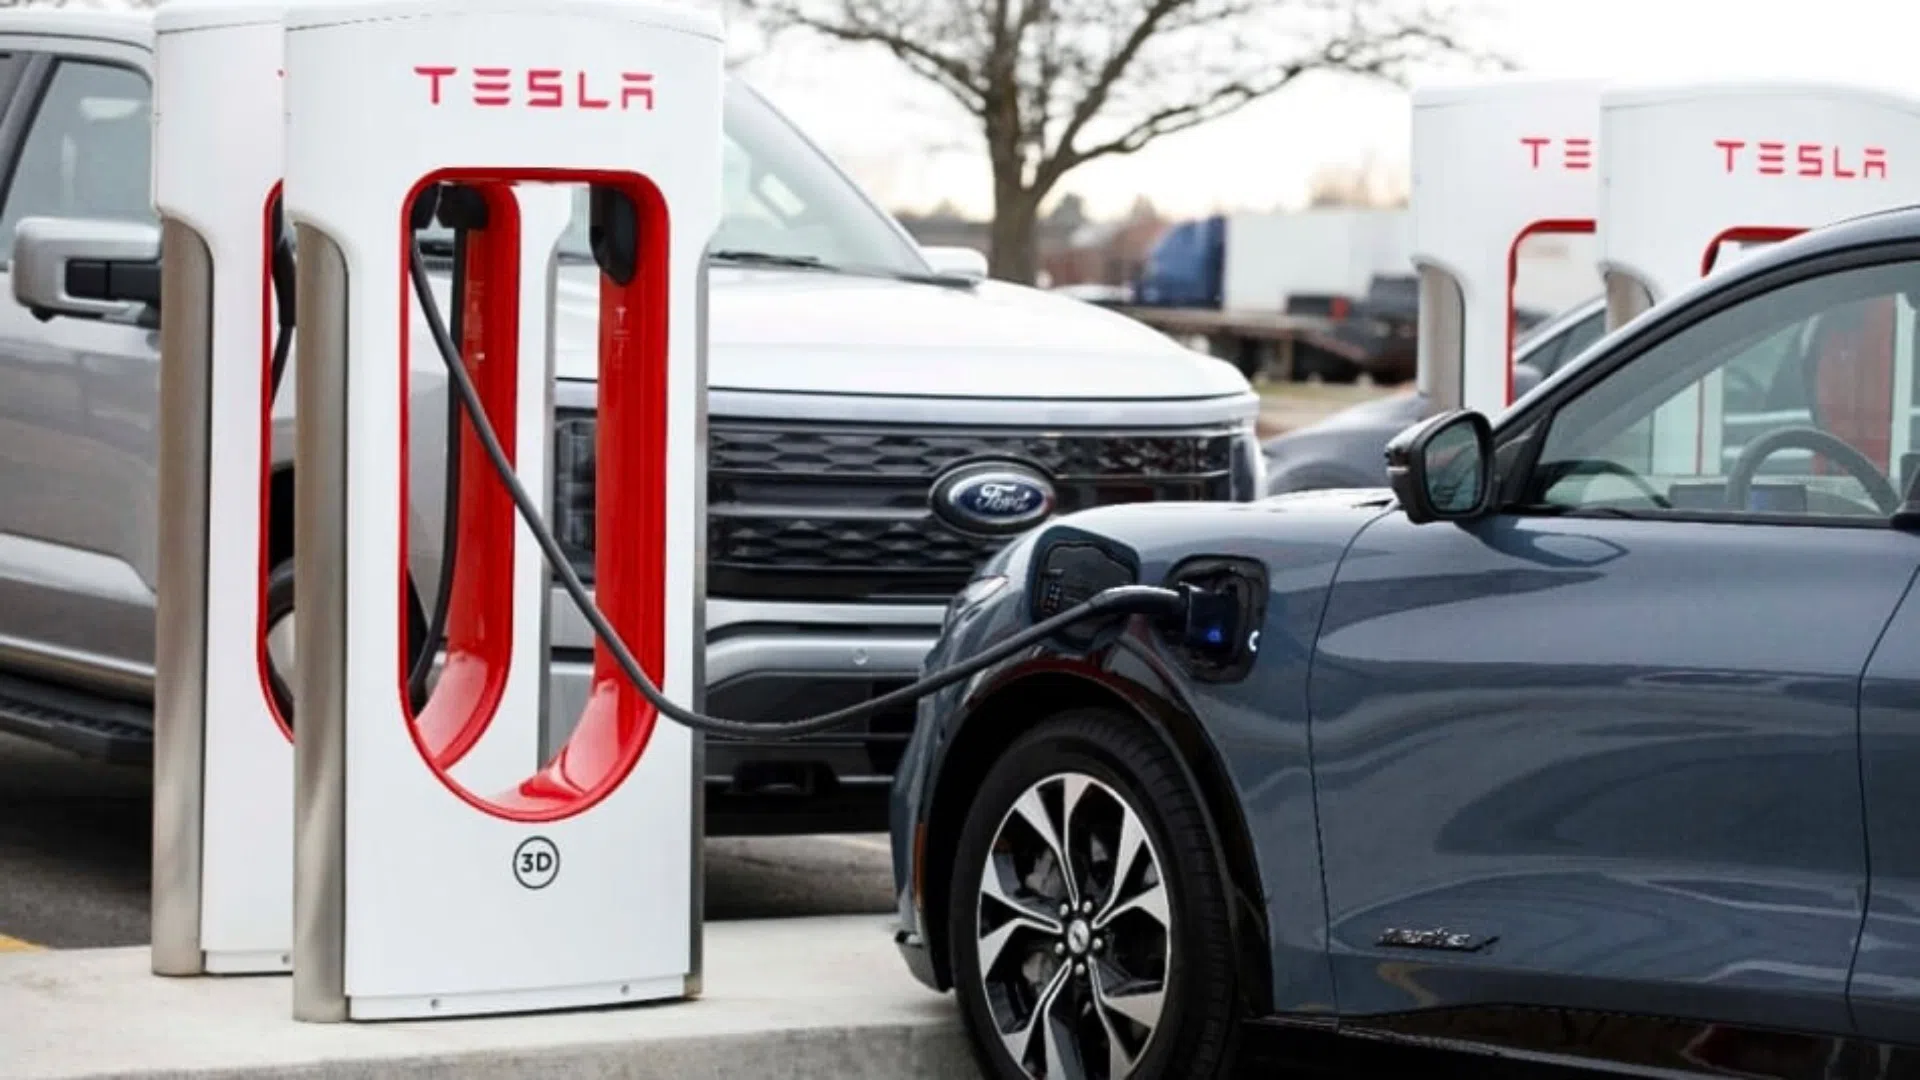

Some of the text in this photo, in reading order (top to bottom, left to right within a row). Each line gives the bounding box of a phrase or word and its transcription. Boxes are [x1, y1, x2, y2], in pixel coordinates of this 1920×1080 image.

[415, 65, 655, 111] TESLA
[1714, 140, 1888, 180] TESLA
[974, 483, 1032, 512] Ford
[520, 852, 553, 873] 3D
